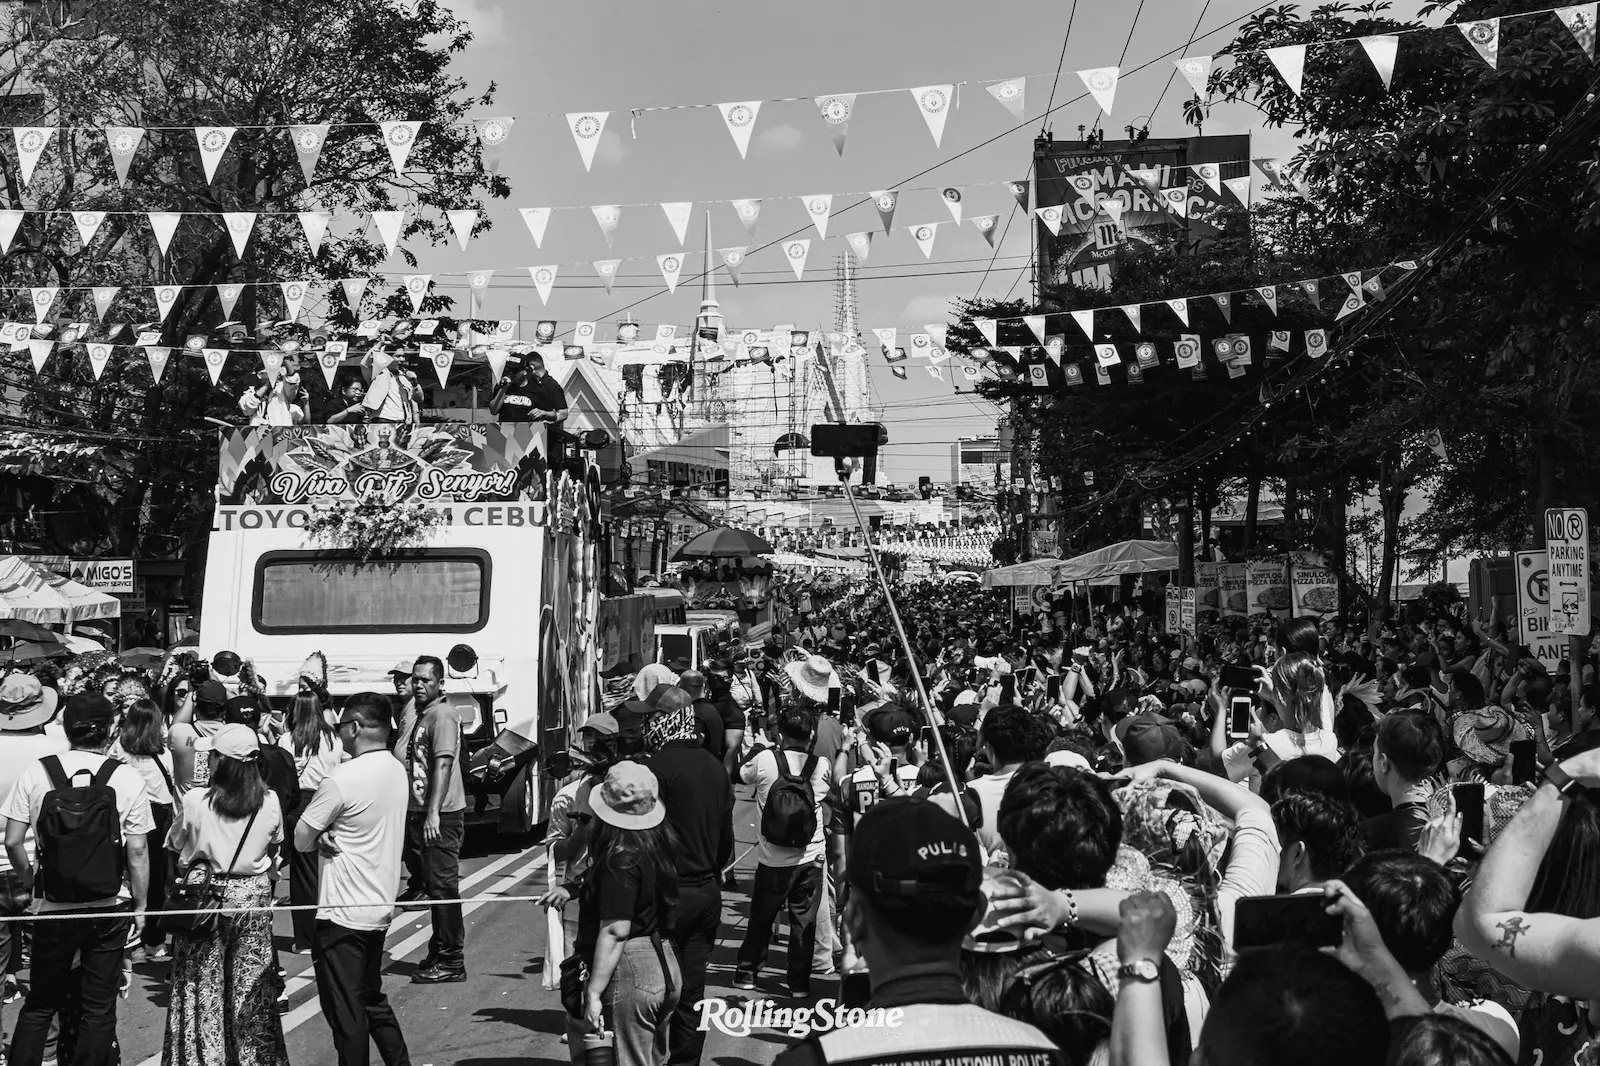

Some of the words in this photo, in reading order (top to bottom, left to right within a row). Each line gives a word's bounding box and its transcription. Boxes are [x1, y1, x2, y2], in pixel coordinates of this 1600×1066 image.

[271, 469, 349, 503] Viva
[418, 468, 517, 501] Senyor!
[220, 509, 308, 531] TOYO
[464, 506, 545, 527] CEBU
[1547, 513, 1564, 538] NO
[1550, 546, 1584, 560] PARKING
[86, 566, 132, 580] MIGO'S
[1552, 563, 1583, 577] ANYTIME
[1527, 616, 1549, 632] BI
[1536, 644, 1570, 660] ANE
[917, 841, 967, 860] PULIS
[1009, 1054, 1050, 1066] POLICE
